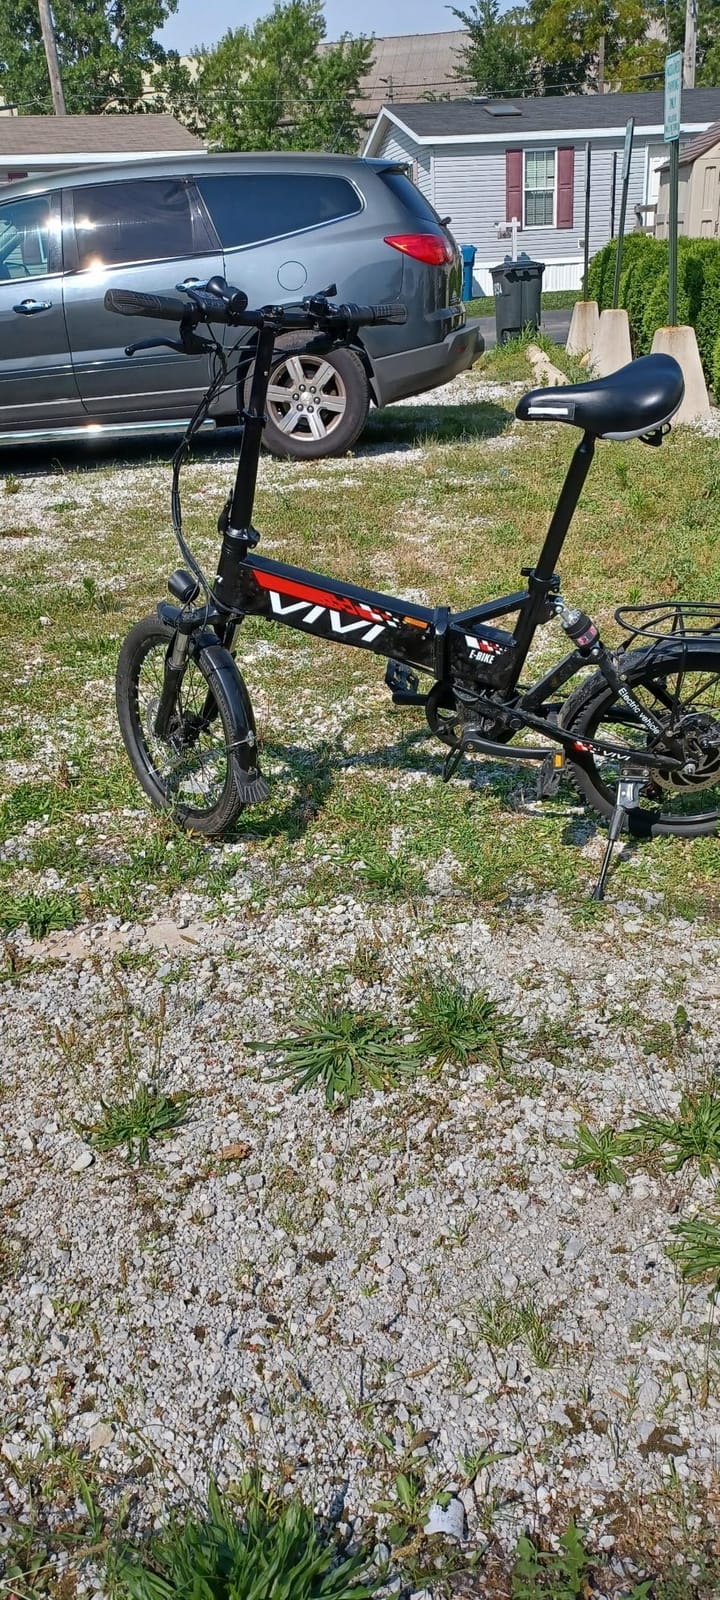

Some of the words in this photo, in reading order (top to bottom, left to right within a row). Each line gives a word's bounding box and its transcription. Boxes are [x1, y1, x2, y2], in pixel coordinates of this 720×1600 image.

[269, 590, 386, 642] VIVI
[469, 650, 495, 664] E-BIKE
[618, 687, 640, 713] Electric
[639, 712, 660, 735] vehicle
[603, 750, 631, 761] VIVI
